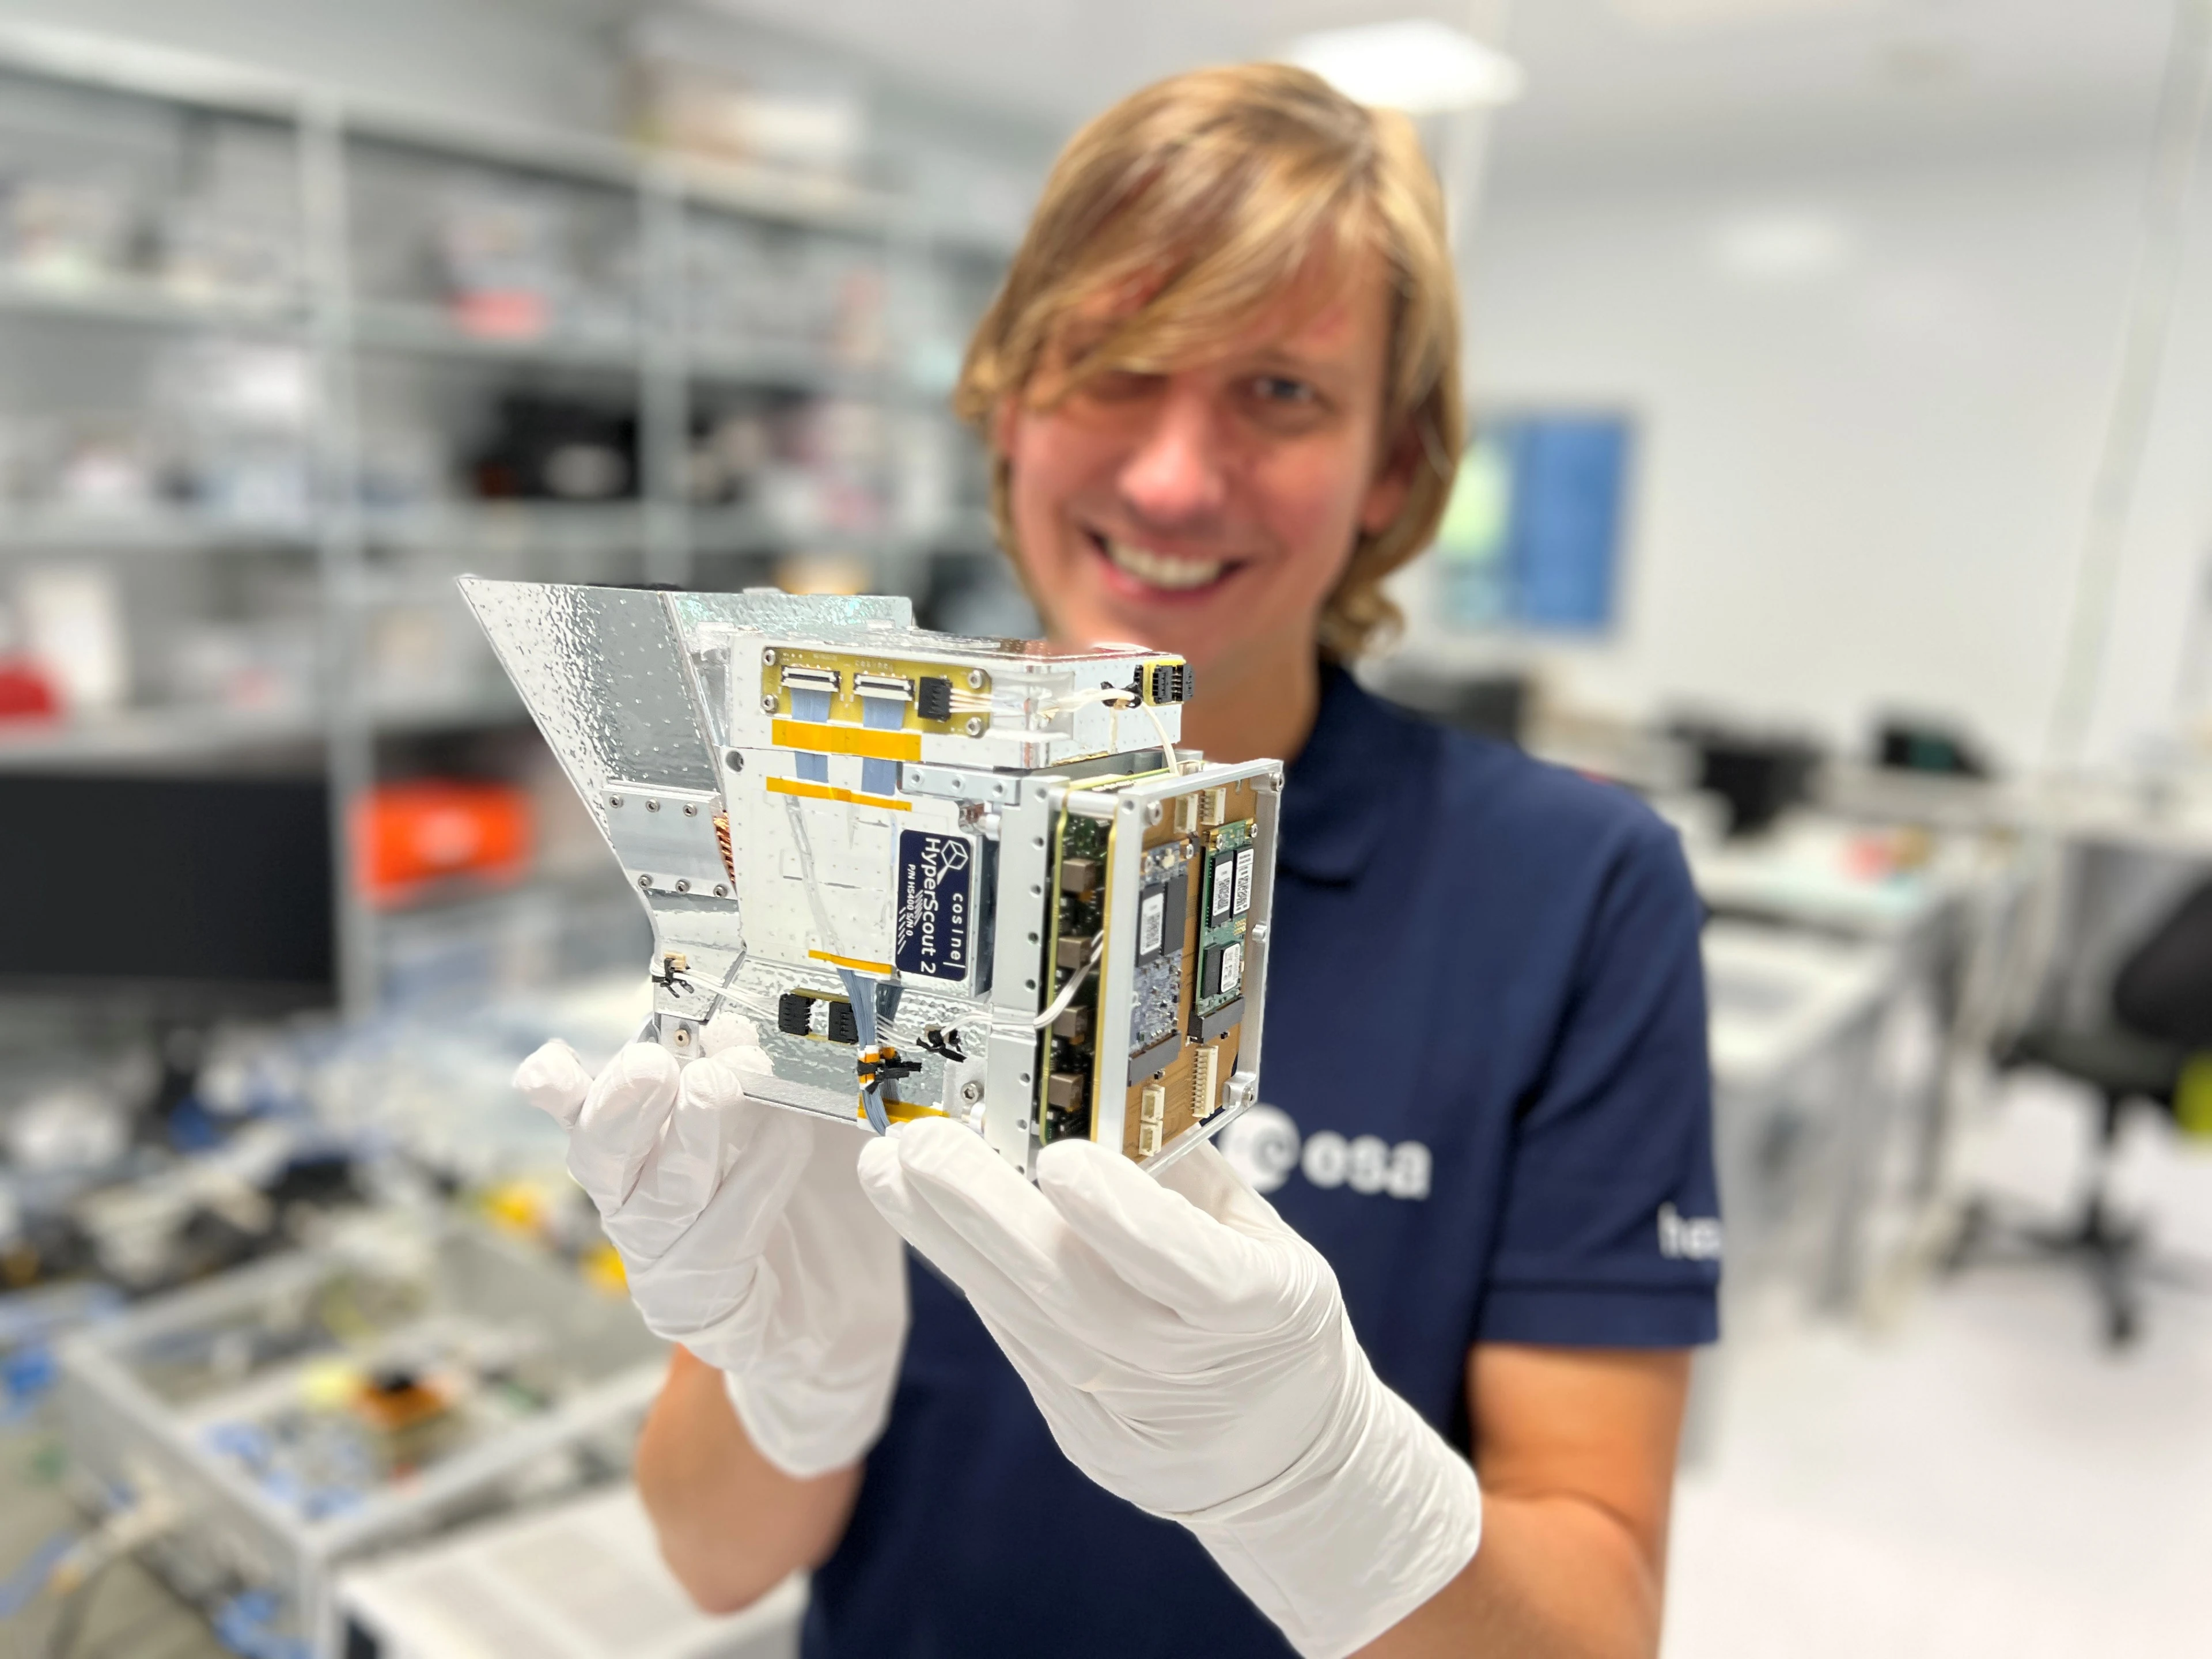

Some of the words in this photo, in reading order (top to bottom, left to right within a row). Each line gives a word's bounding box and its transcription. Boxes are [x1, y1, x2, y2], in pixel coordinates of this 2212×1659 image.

[907, 863, 916, 880] P/N
[907, 881, 915, 911] HS400
[921, 837, 941, 956] HyperScout
[906, 911, 915, 929] S/N
[950, 893, 964, 960] cosine
[921, 961, 936, 974] 2
